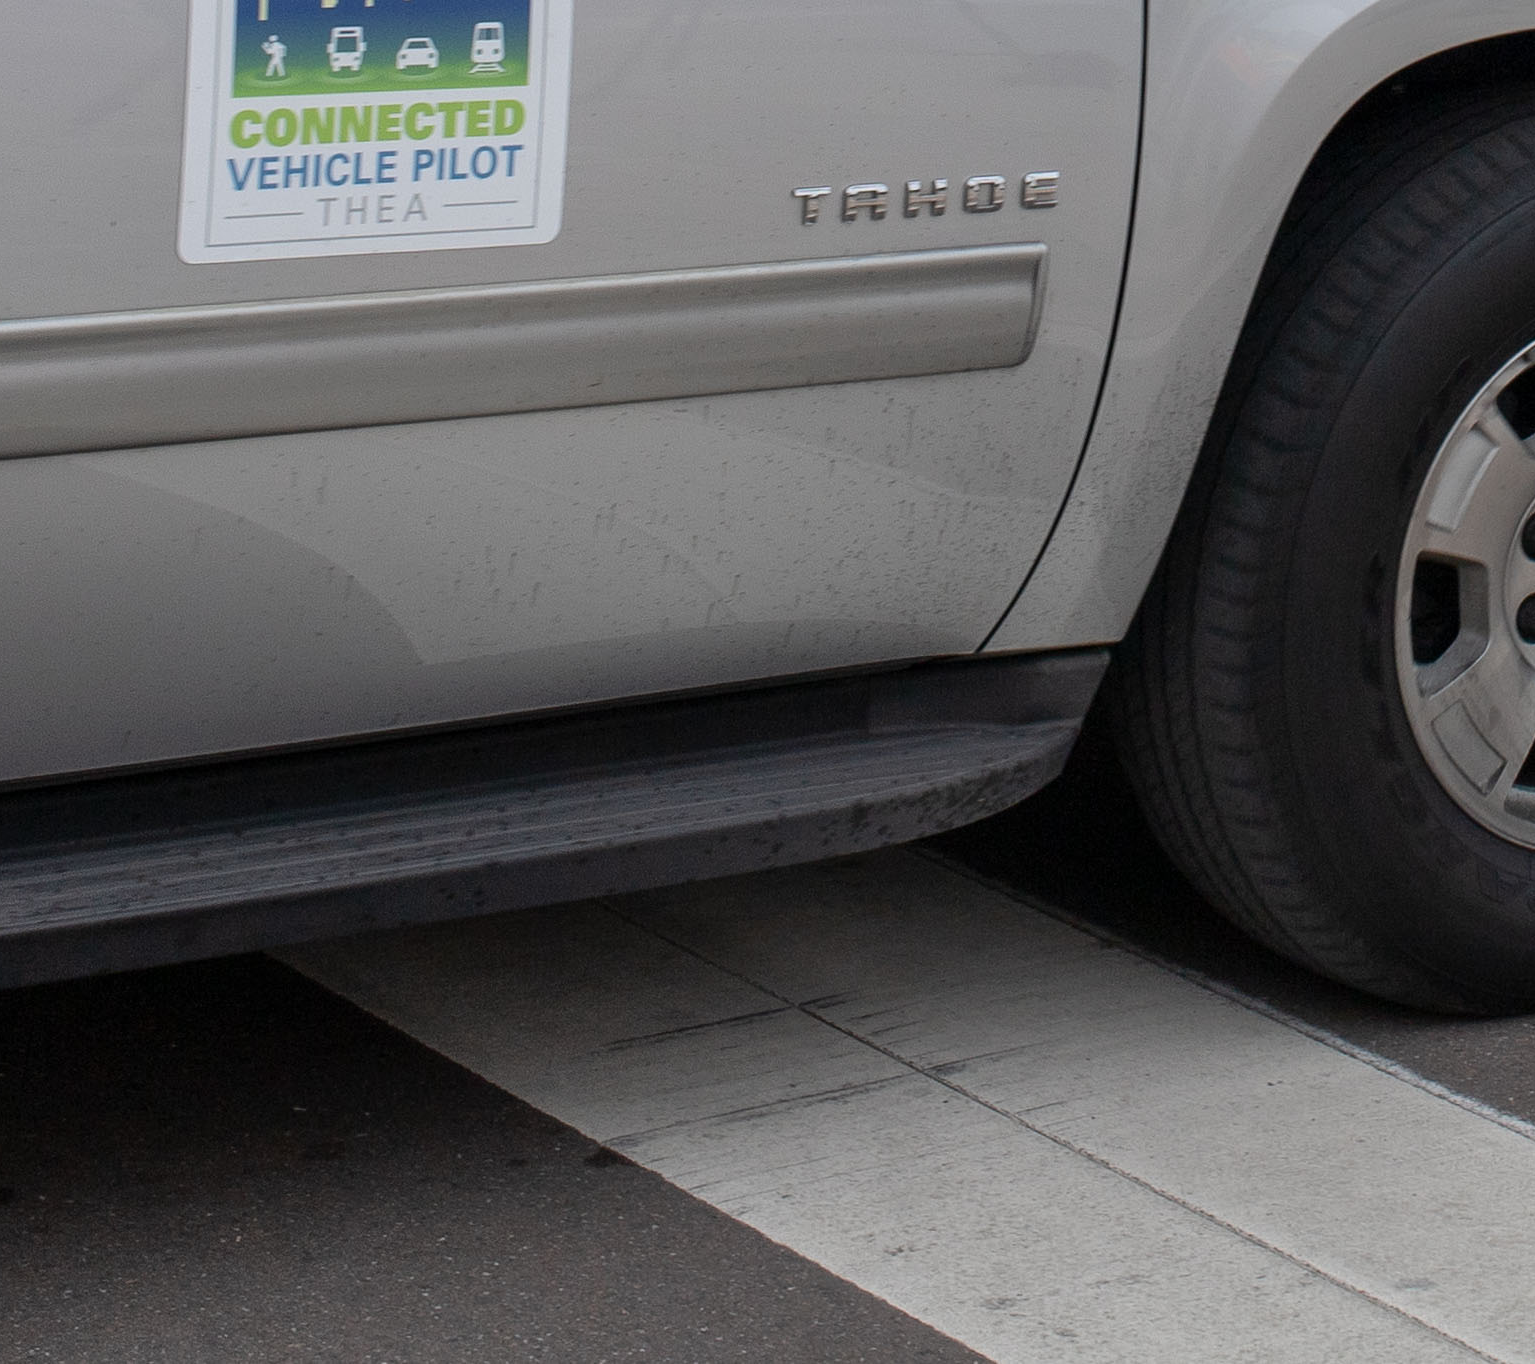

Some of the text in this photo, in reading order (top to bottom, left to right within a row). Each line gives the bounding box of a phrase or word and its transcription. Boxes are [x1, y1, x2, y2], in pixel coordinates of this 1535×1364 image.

[229, 98, 526, 149] CONNECTED
[226, 144, 525, 191] VEHICLE PILOT
[317, 192, 429, 227] THEA
[791, 171, 1060, 224] TAHOE
